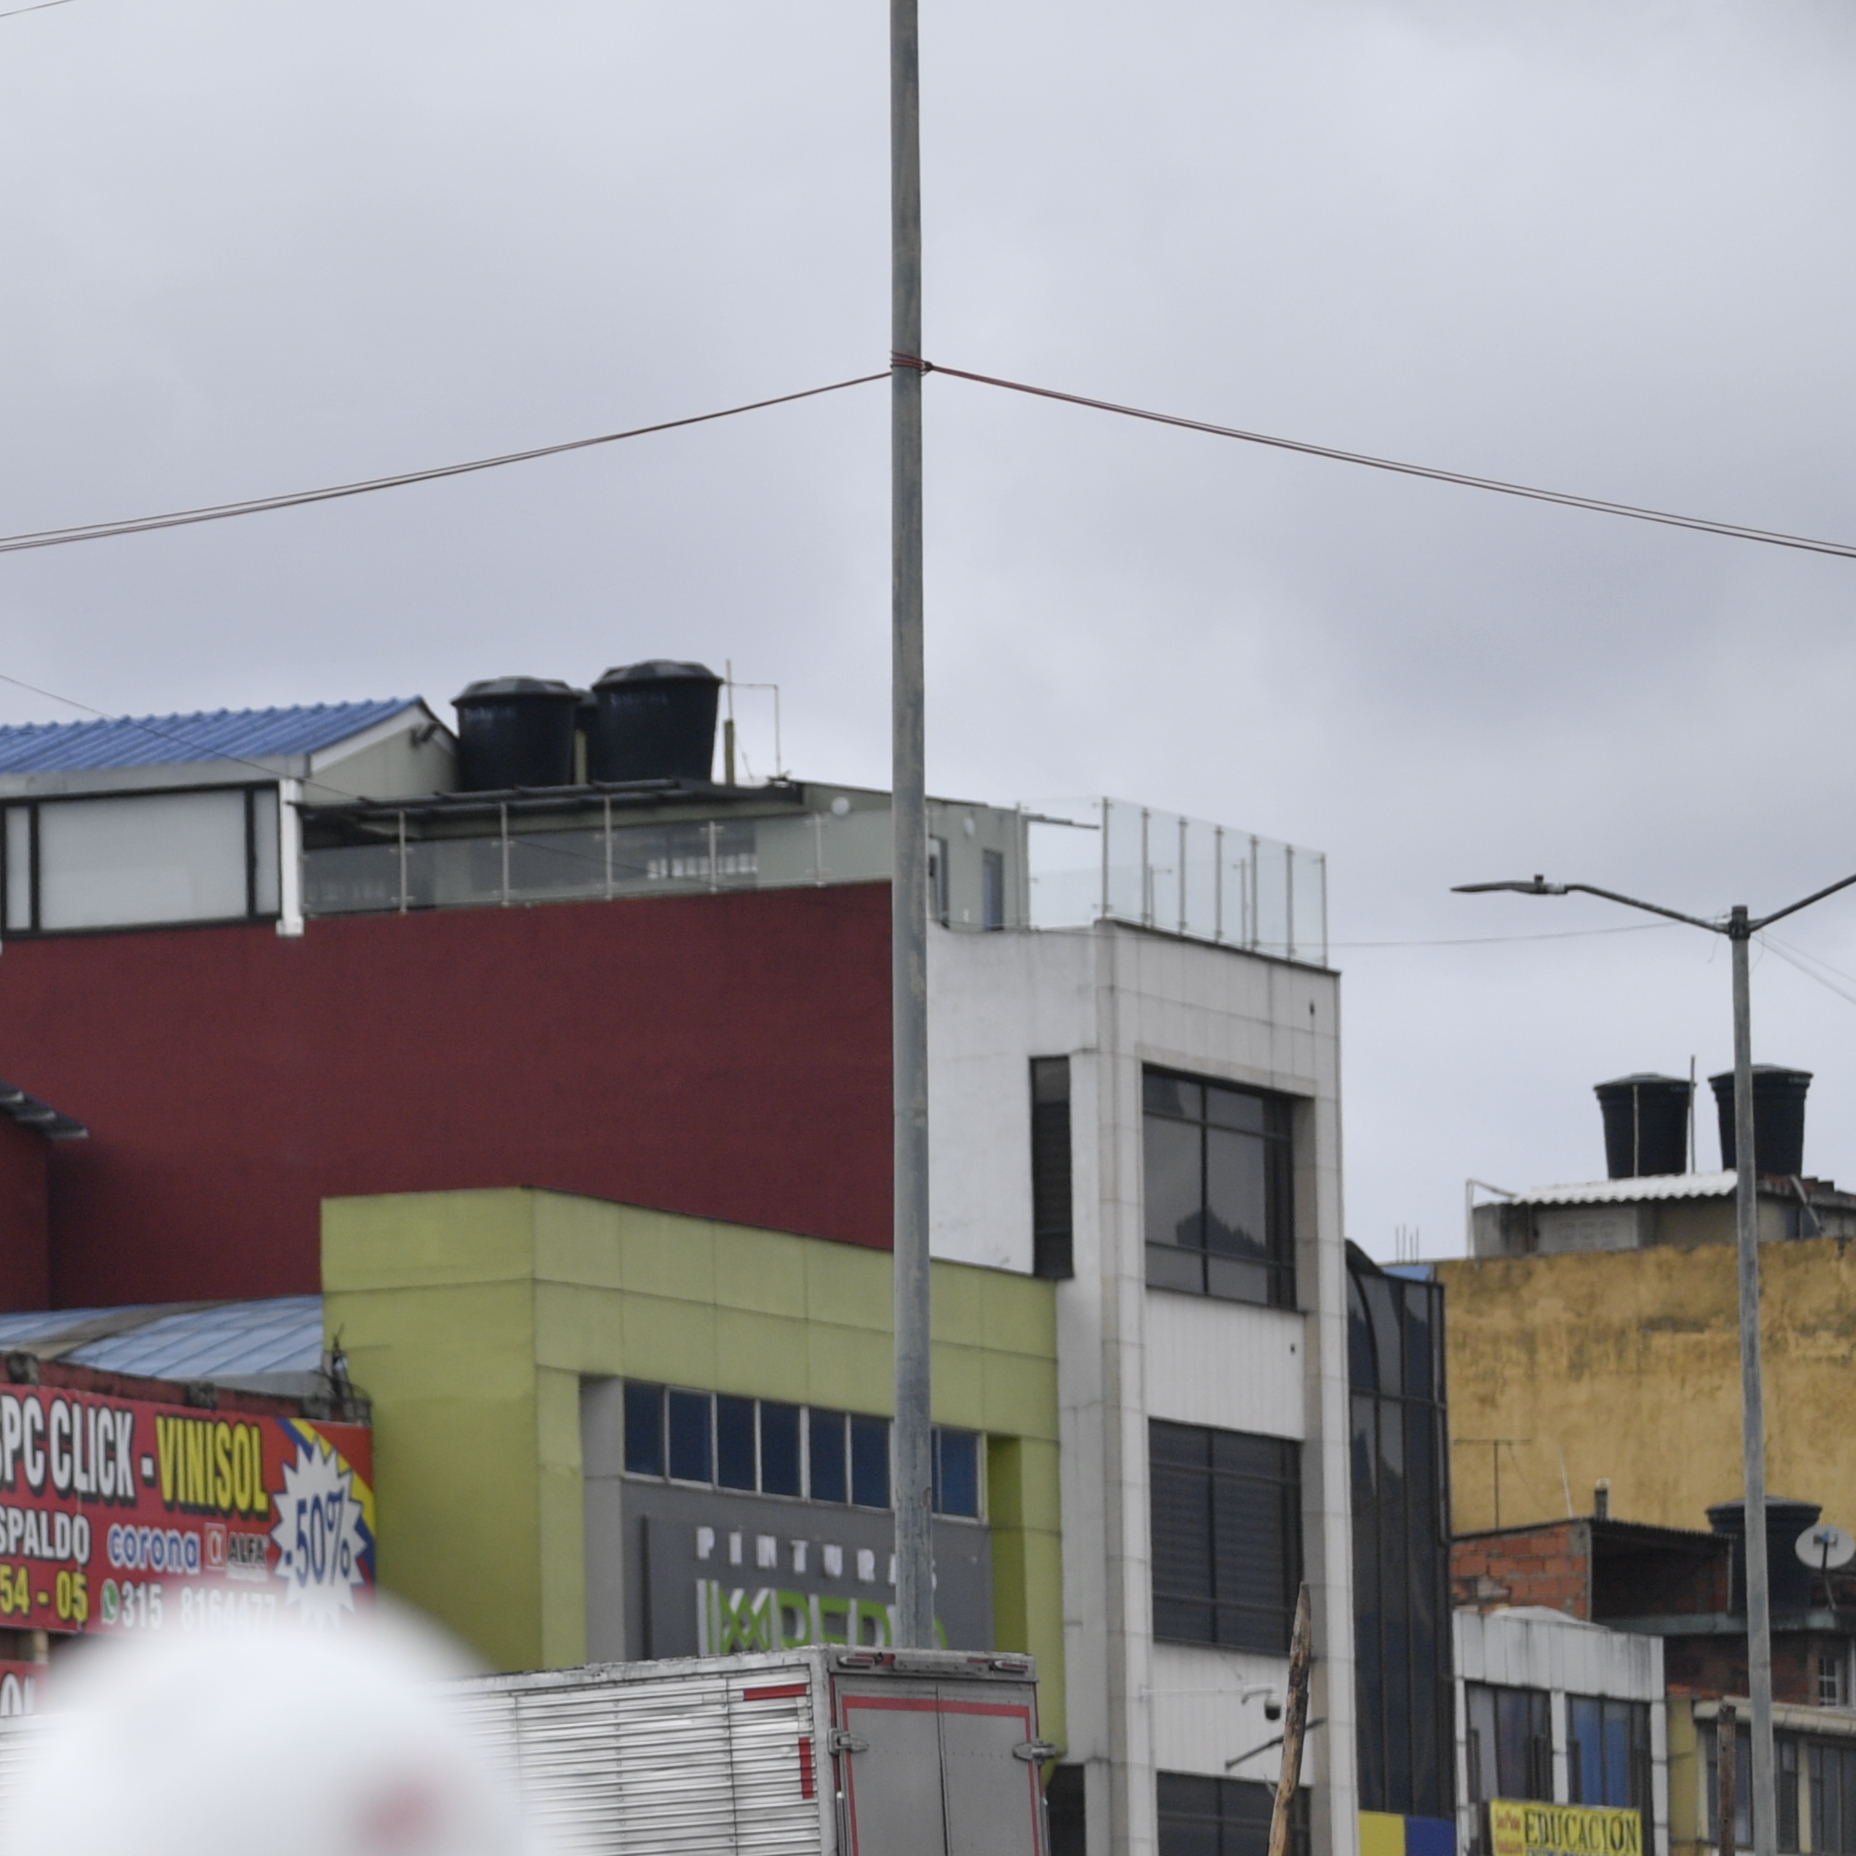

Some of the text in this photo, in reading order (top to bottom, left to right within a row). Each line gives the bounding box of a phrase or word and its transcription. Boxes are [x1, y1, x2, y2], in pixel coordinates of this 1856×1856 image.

[50, 1397, 135, 1499] CLICK
[156, 1415, 268, 1512] VINISOL
[107, 1523, 267, 1574] corona ALFA
[56, 1570, 88, 1622] 05
[121, 1583, 164, 1630] 315
[1523, 1811, 1636, 1852] EDUCACIÓN
